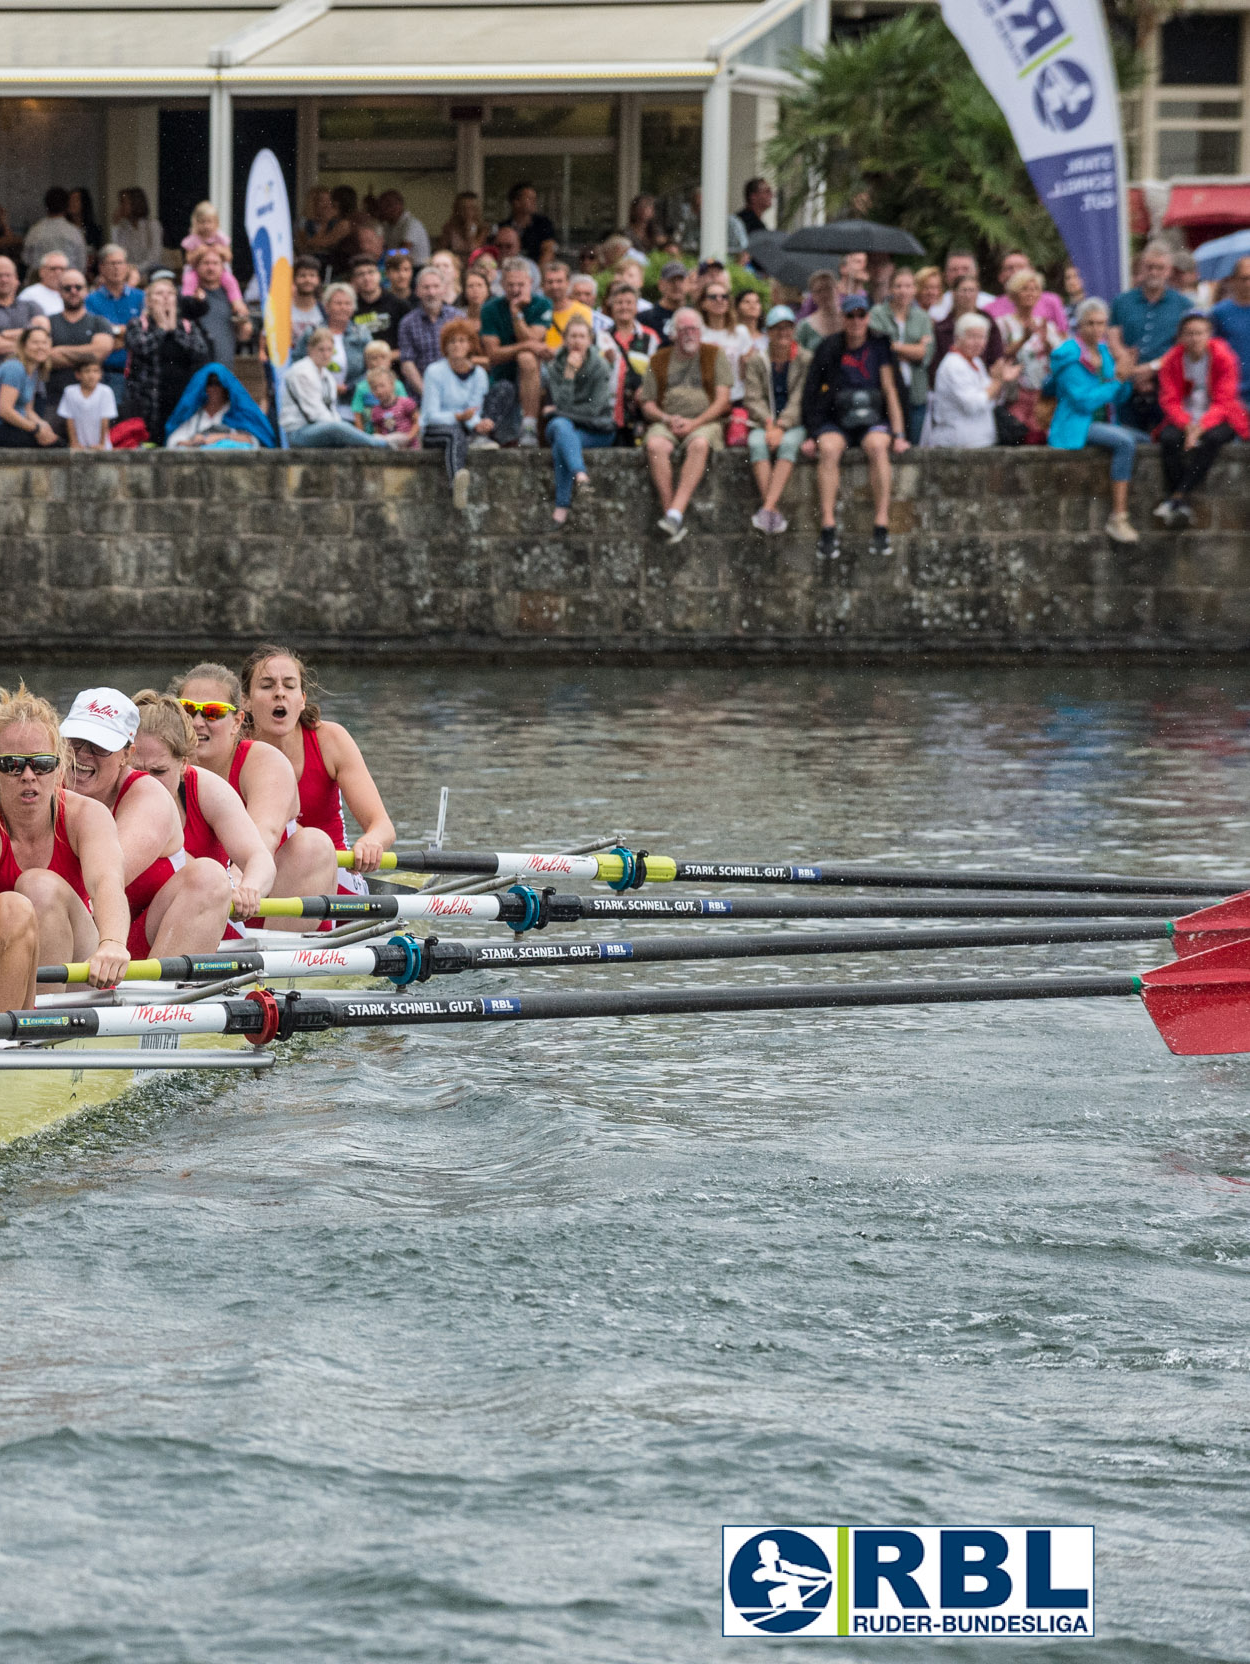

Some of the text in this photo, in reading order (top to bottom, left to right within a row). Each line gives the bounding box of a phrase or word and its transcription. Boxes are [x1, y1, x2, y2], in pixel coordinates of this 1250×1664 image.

[84, 699, 115, 719] Melitta
[520, 853, 573, 874] Melitta
[684, 865, 787, 878] STARK. SCHNELL. GUT.
[797, 868, 816, 876] RBL
[421, 895, 475, 916] Melitta
[593, 900, 697, 912] STARK. SCHNELL. GUT.
[708, 901, 727, 910] RBL
[481, 945, 595, 959] STARK. SCHNELL. GUT.
[606, 944, 627, 954] RBL
[290, 949, 350, 967] Melitta
[347, 1000, 477, 1017] STARK. SCHNELL. GUT.
[491, 999, 514, 1009] RBL
[129, 1005, 197, 1024] Melitta
